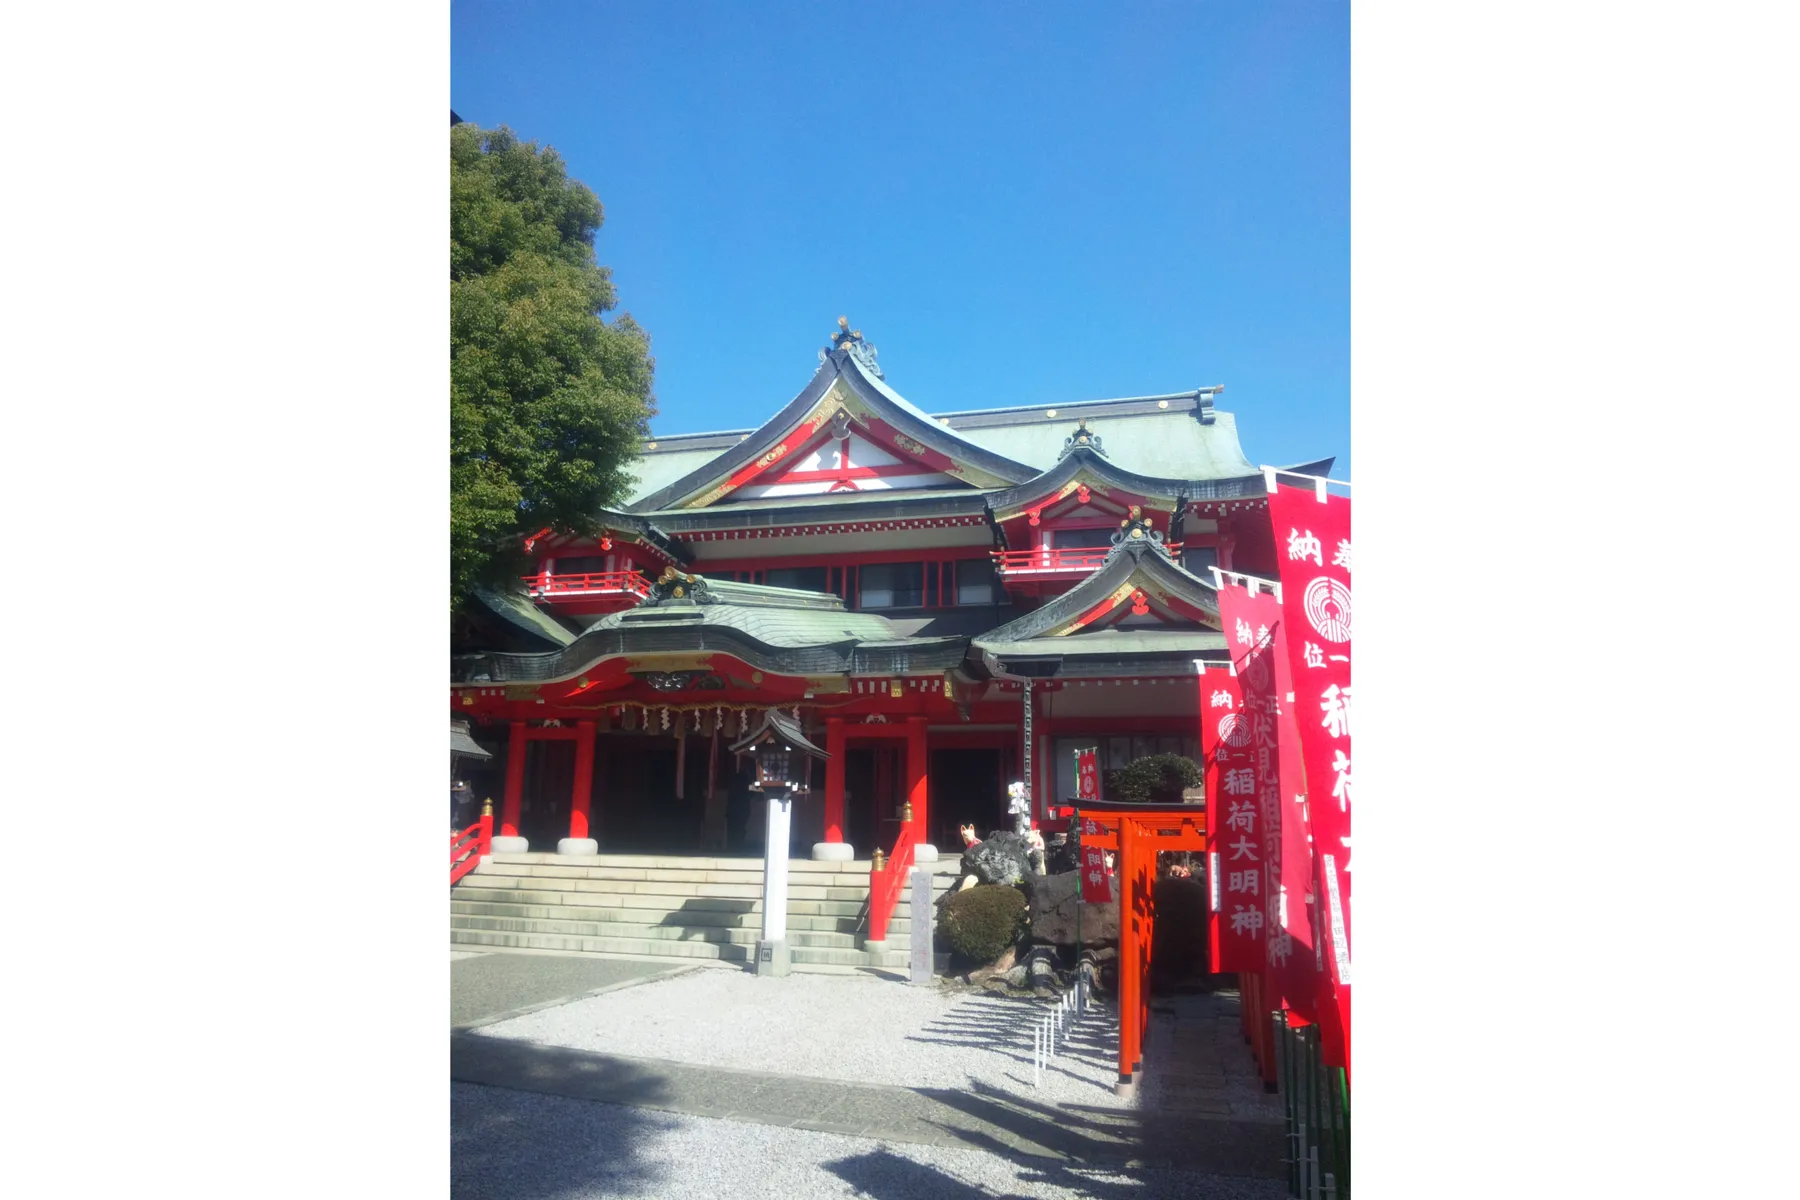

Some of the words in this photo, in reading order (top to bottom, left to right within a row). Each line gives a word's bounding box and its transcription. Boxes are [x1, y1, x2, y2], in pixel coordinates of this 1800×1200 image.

[1223, 767, 1264, 941] 稲荷大明神
